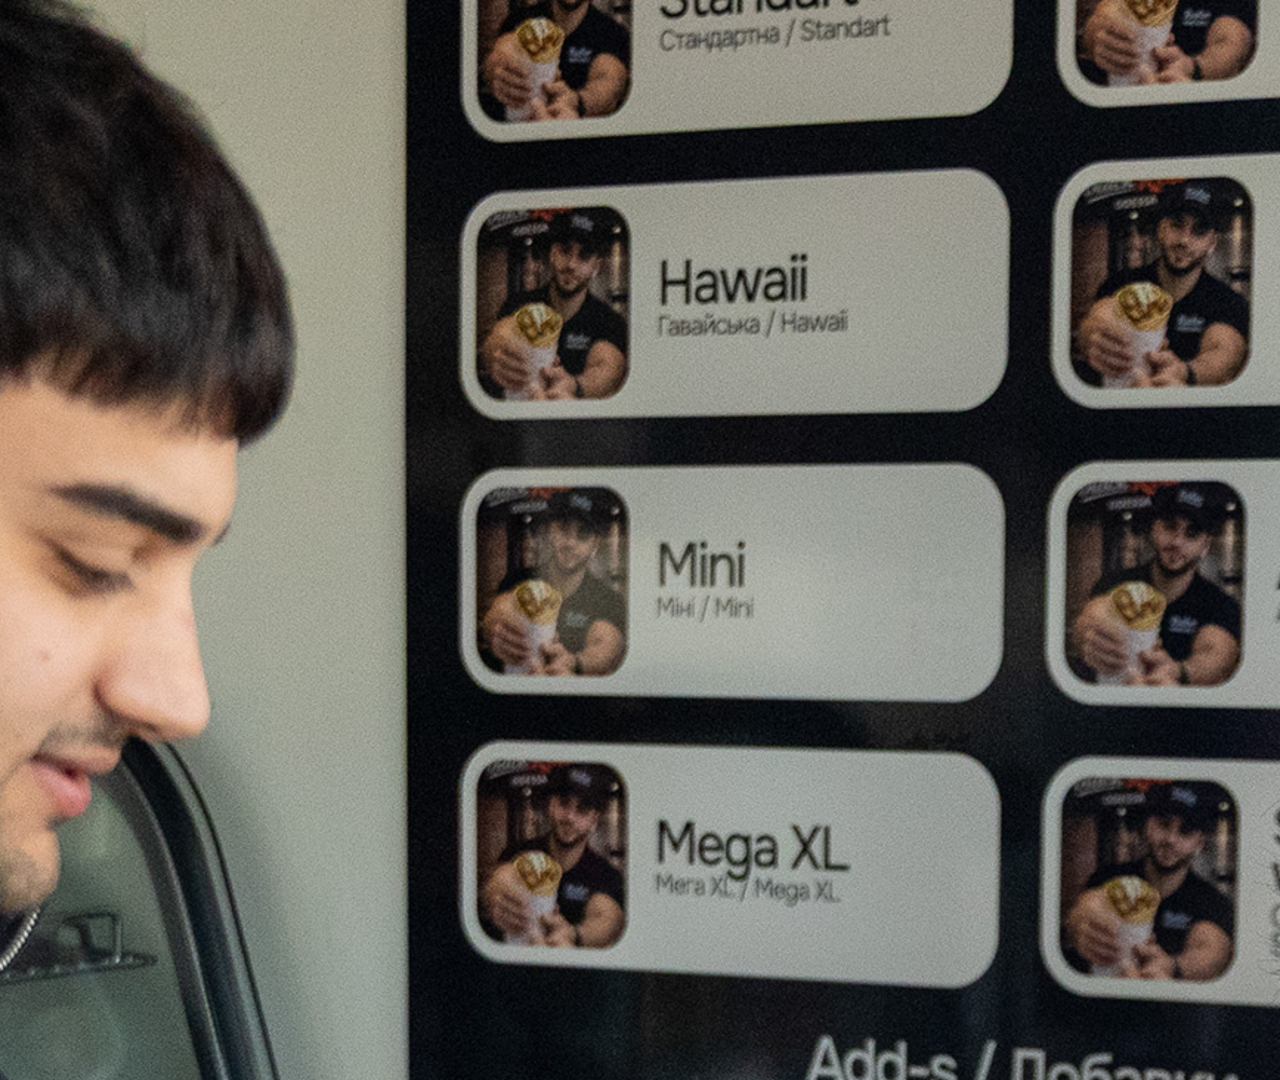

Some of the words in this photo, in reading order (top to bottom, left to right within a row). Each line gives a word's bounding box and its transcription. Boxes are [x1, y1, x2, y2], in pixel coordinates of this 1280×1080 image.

[660, 28, 780, 52] Стандартна
[784, 18, 797, 48] /
[800, 15, 892, 43] Standart
[660, 253, 809, 306] Hawaii
[658, 312, 761, 337] Гавайська
[765, 308, 777, 339] /
[781, 308, 850, 334] Hawaii
[659, 540, 746, 588] Mini
[699, 594, 710, 623] /
[715, 596, 754, 618] Mini
[658, 819, 780, 882] Mega
[791, 823, 851, 872] XL
[754, 877, 812, 908] Mega
